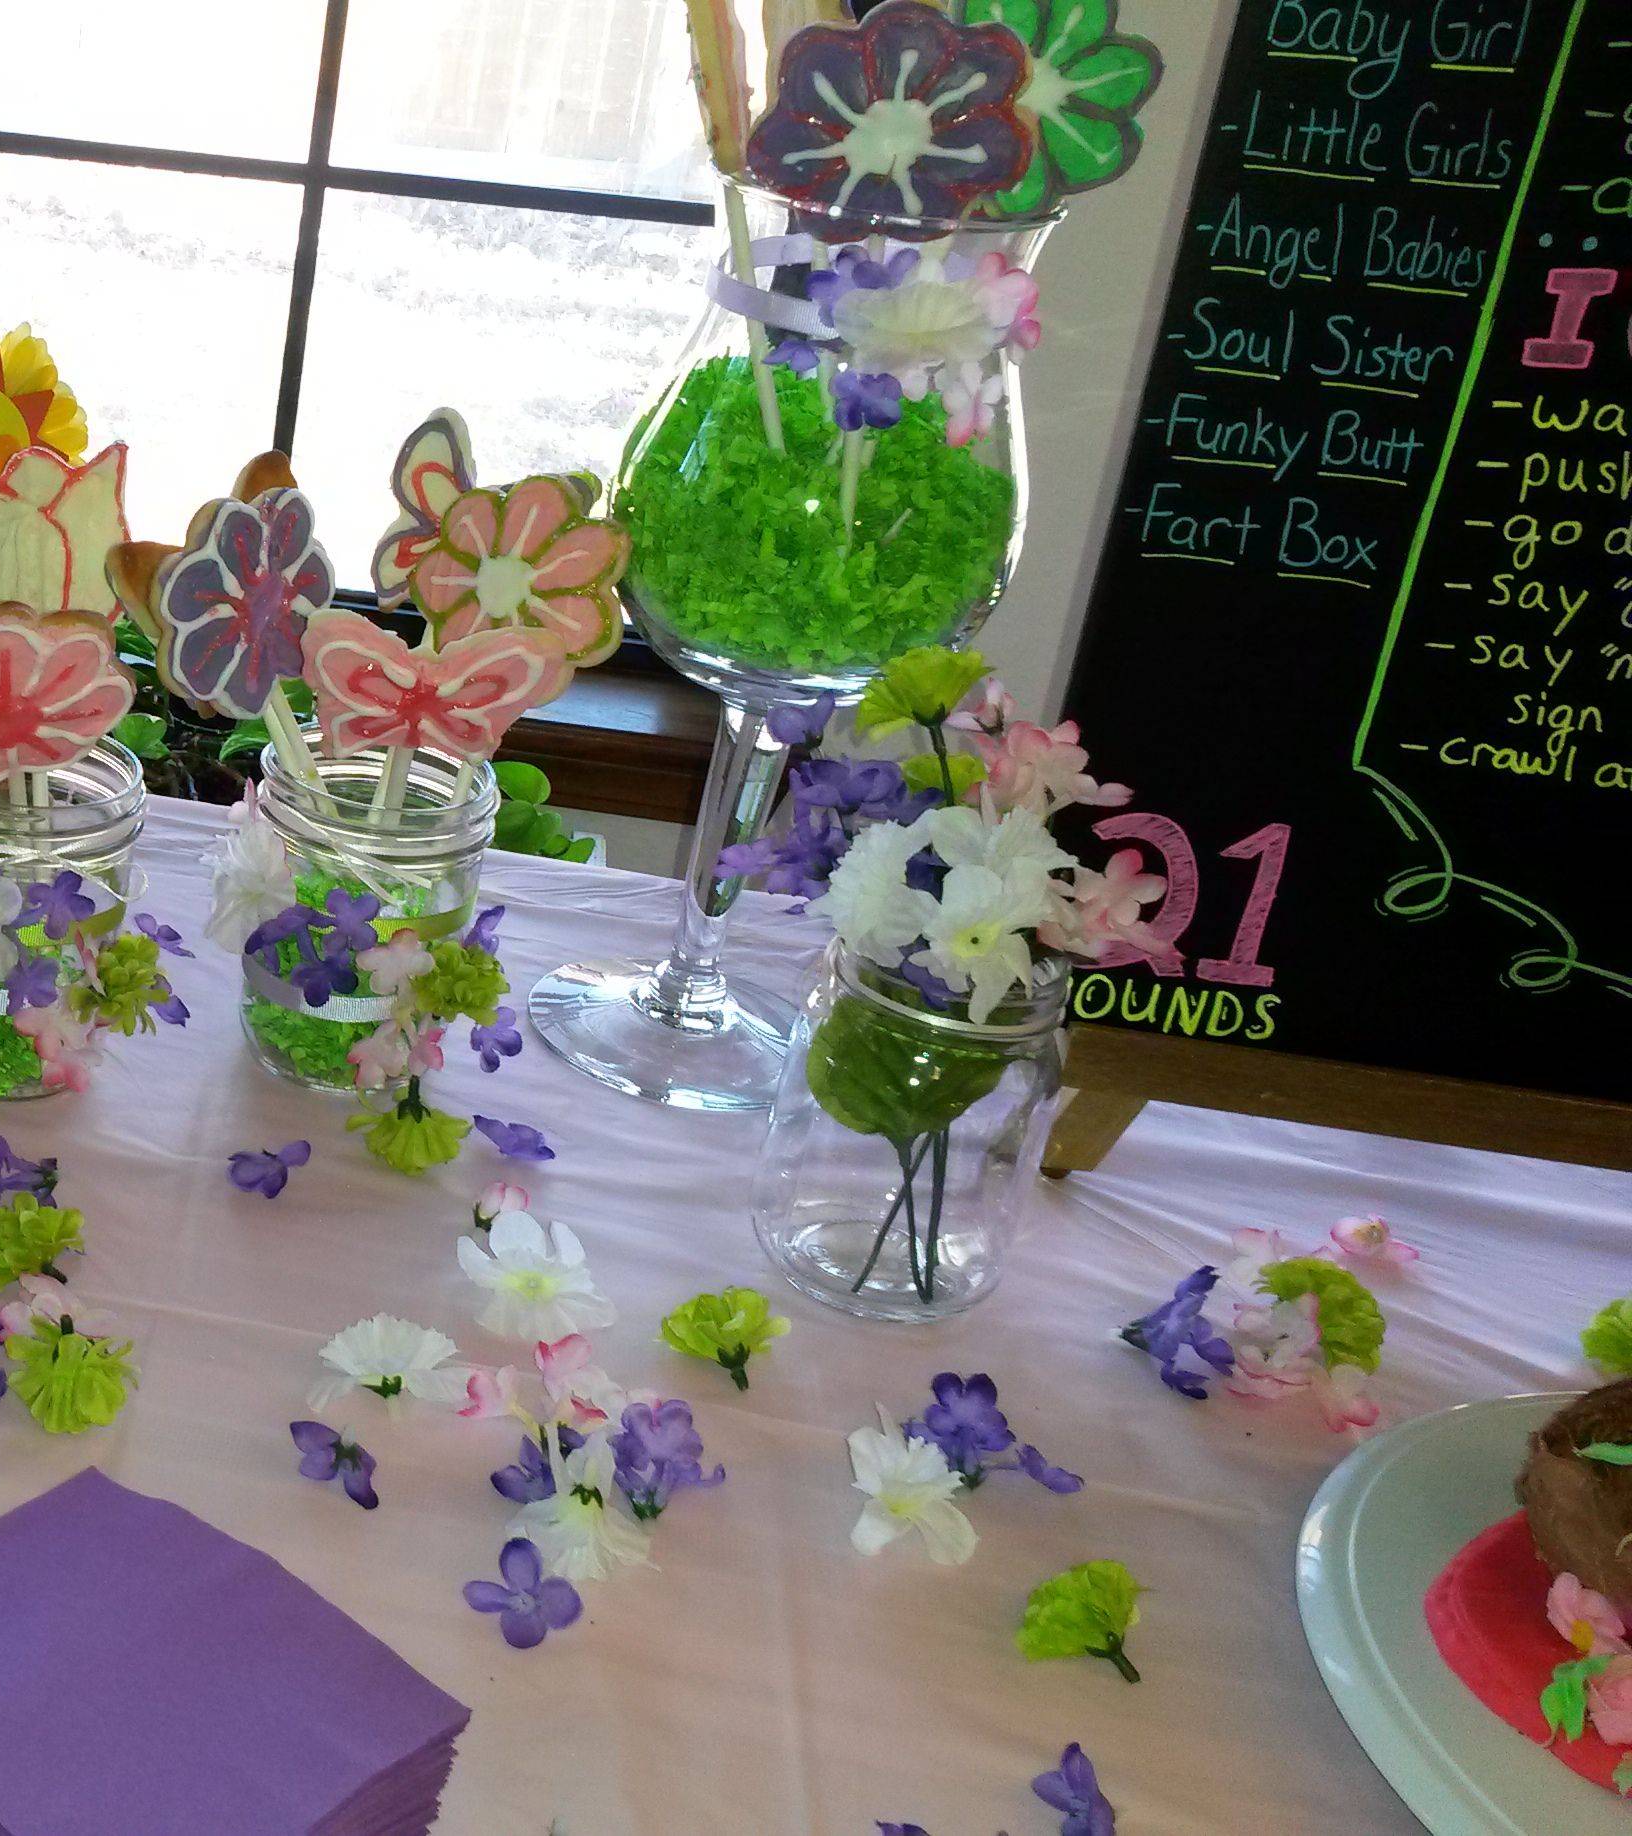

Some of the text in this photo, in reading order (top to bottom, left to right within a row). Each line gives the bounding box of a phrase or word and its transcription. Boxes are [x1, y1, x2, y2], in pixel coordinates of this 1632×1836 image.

[1268, 0, 1532, 99] Baby Girl
[1405, 101, 1512, 180] Girls
[1364, 206, 1486, 287] Babies
[1311, 315, 1454, 383] Sister
[1521, 267, 1618, 369] I
[1318, 409, 1424, 474] Butt
[1278, 497, 1378, 570] Box
[1507, 691, 1603, 757] sign
[1067, 973, 1281, 1041] OUNDS
